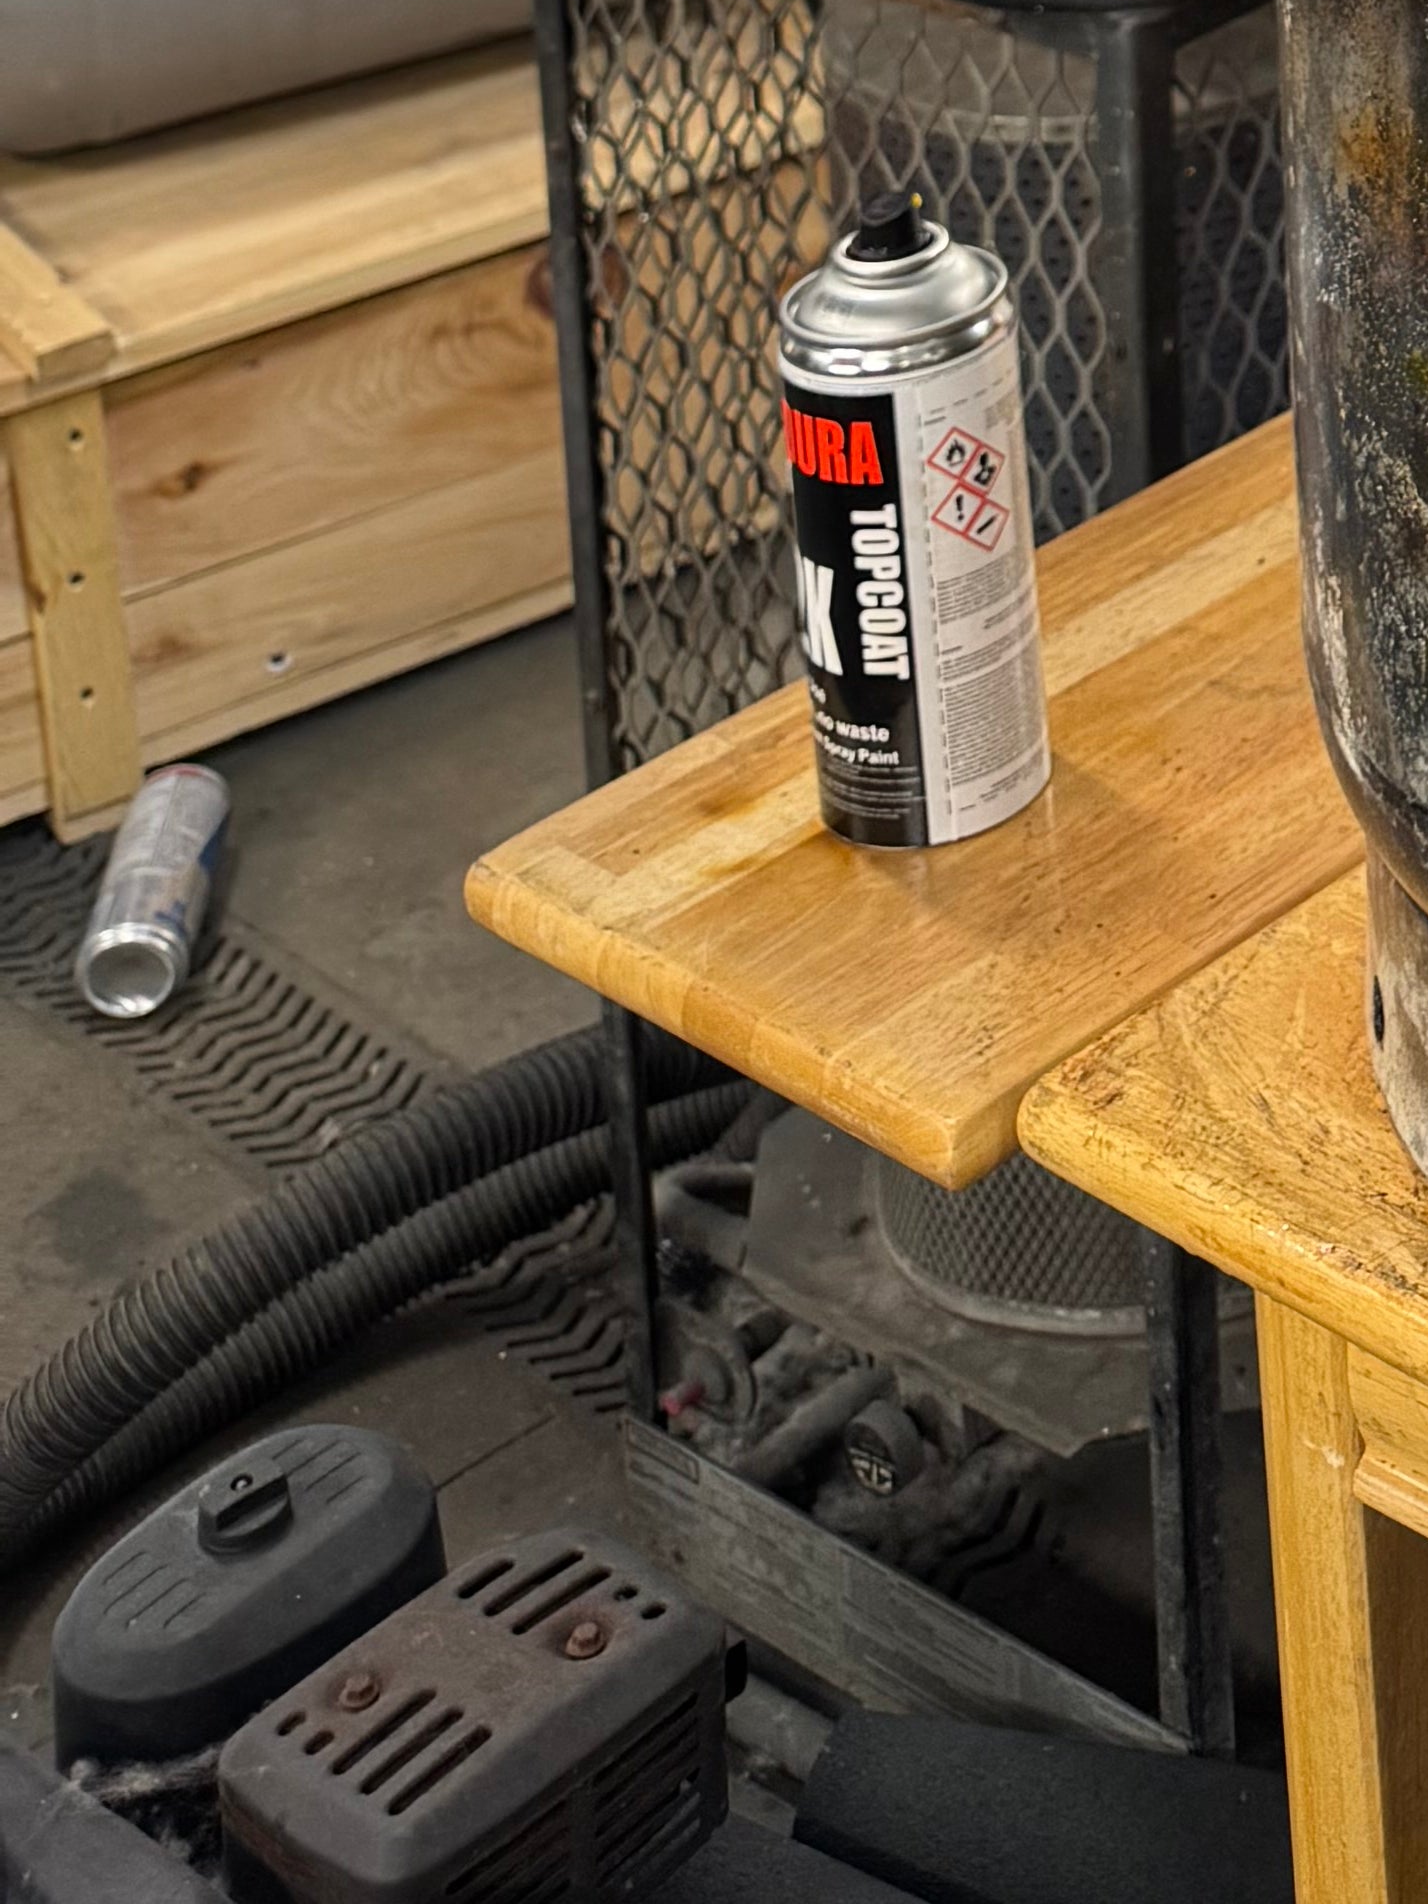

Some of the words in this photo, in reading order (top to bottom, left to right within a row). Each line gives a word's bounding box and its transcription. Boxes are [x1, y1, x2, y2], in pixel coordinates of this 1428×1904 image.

[849, 502, 910, 681] TOPCOAT
[836, 719, 890, 743] waste
[857, 747, 900, 766] Paint
